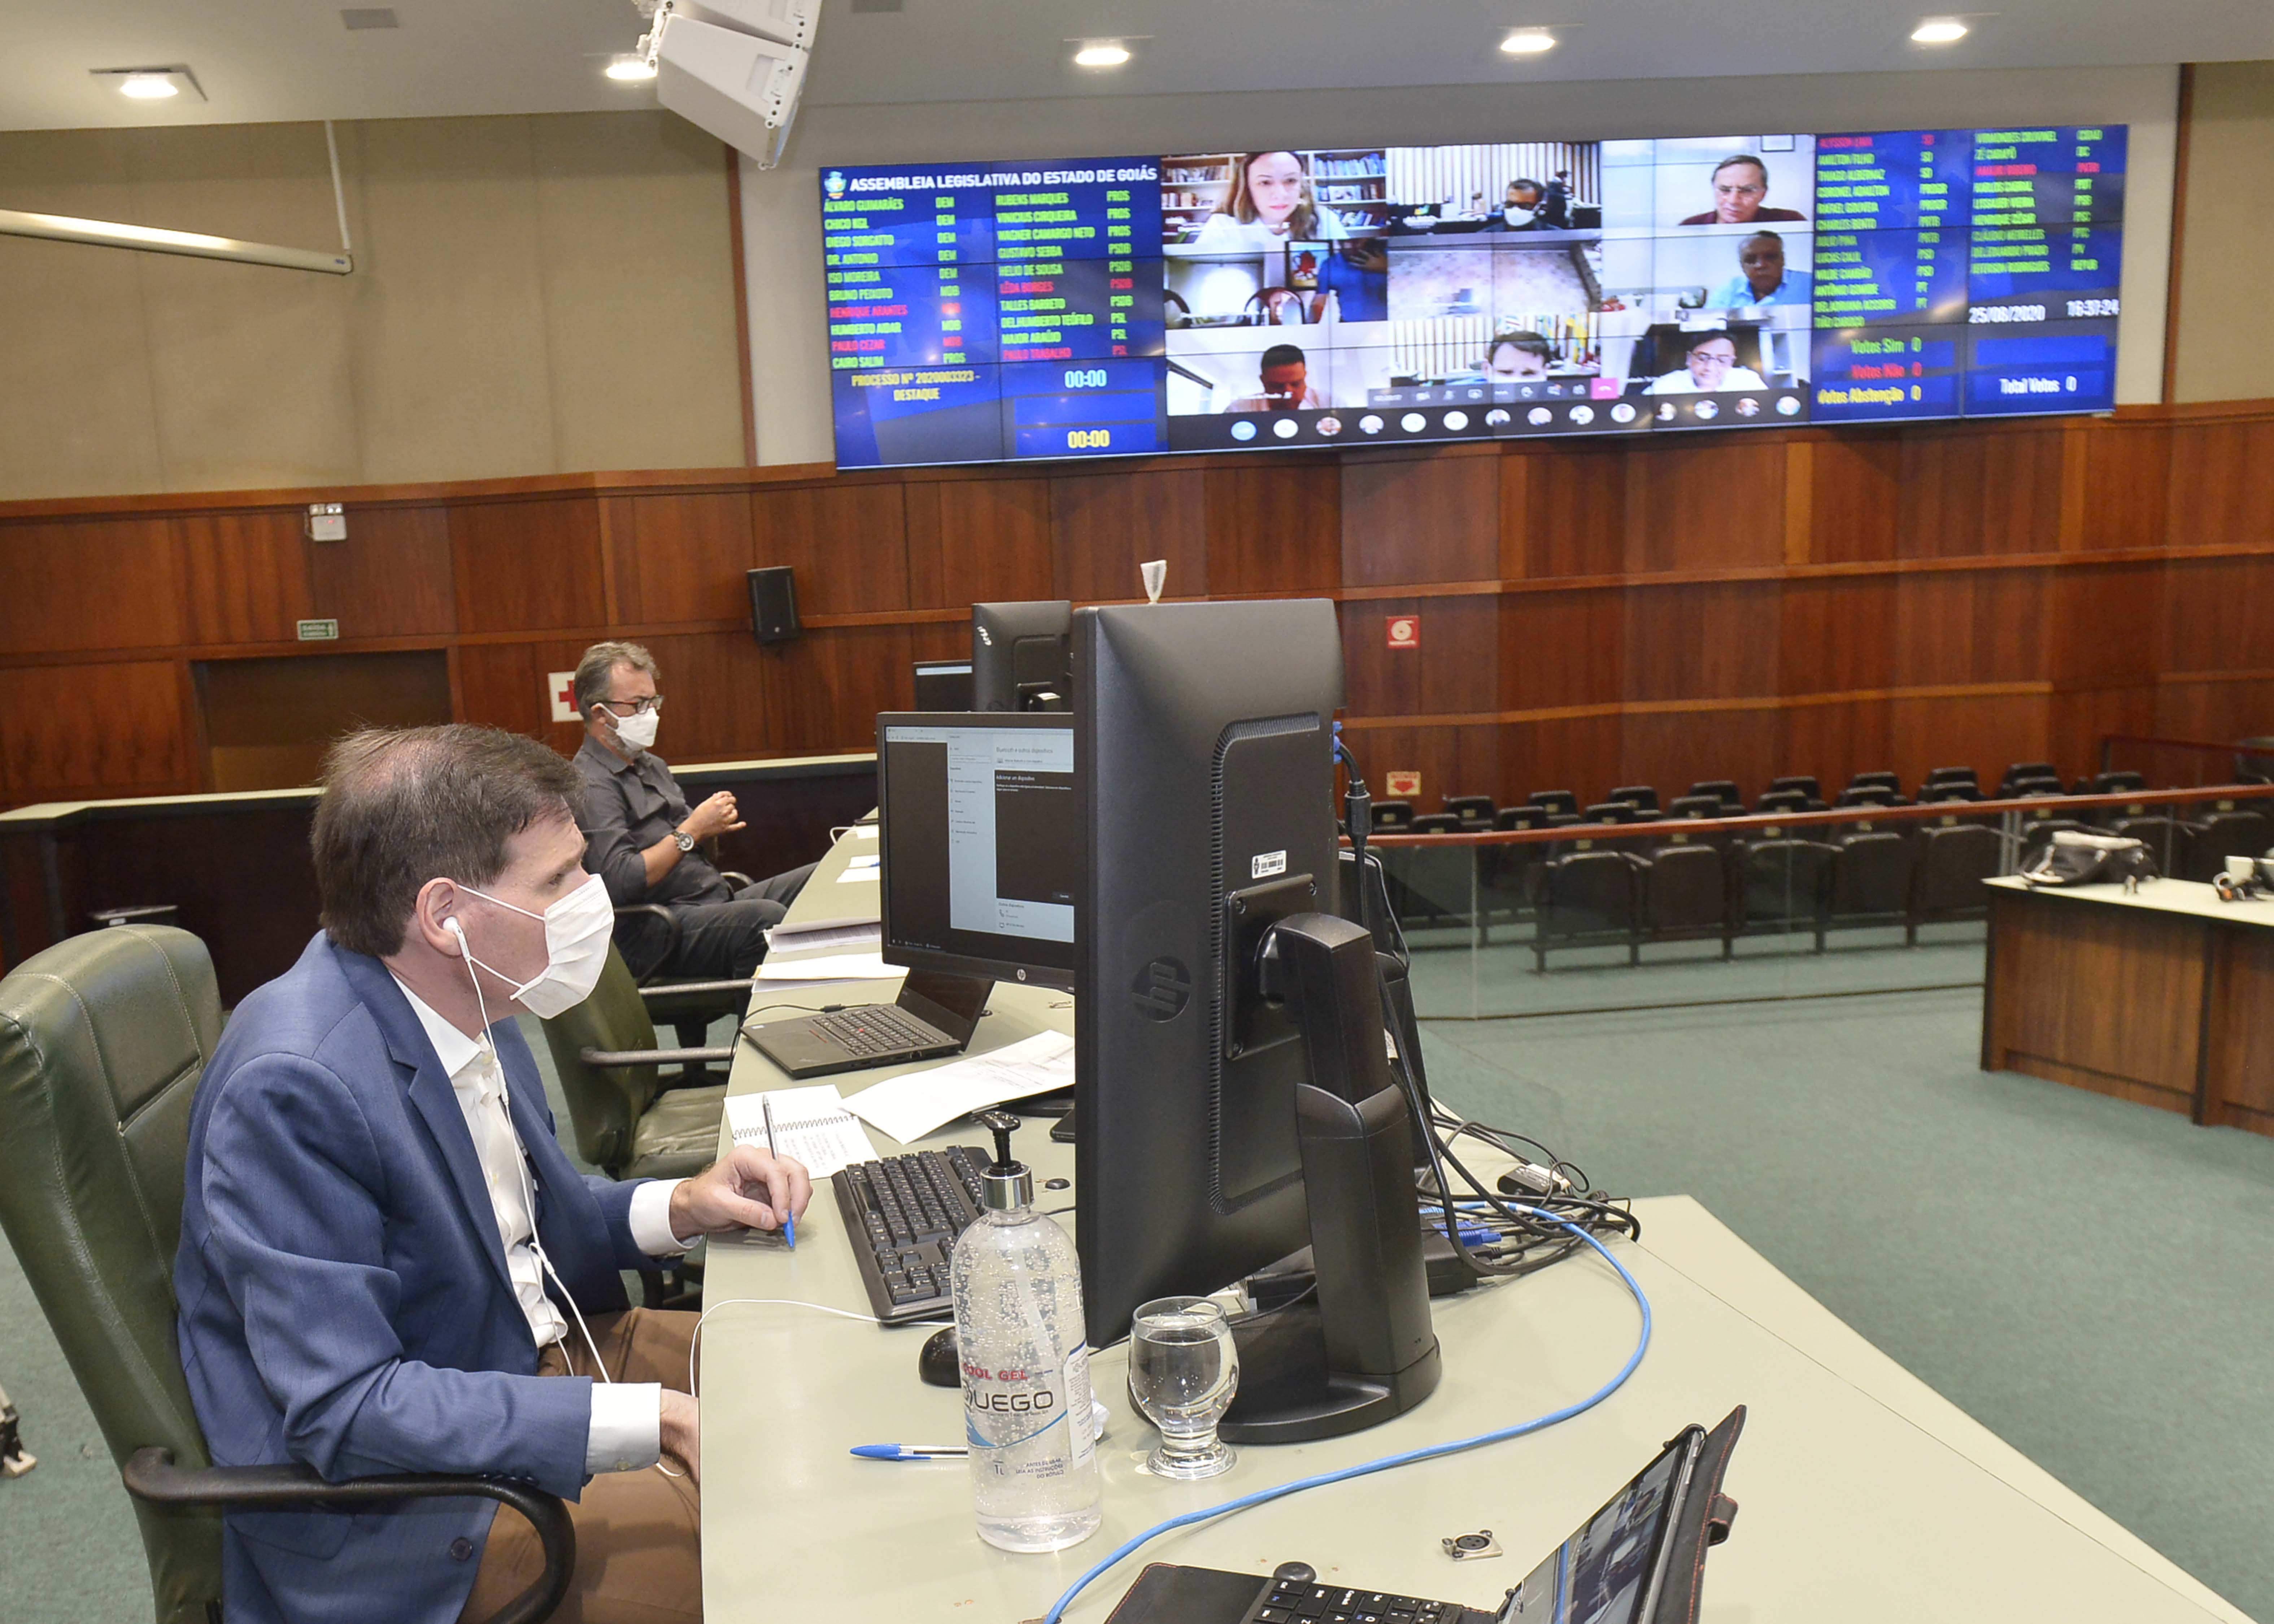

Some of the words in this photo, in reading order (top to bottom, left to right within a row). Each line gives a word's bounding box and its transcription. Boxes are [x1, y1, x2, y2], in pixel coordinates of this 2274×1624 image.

[849, 176, 935, 191] ASSEMBLEIA
[936, 173, 1021, 188] LEGISLATIVA
[1022, 172, 1041, 185] DO
[1043, 170, 1095, 184] ESTADO
[1097, 169, 1116, 183] DE
[1117, 164, 1157, 180] GOIÁS
[1850, 339, 1882, 354] Votos
[1882, 338, 1904, 353] Sim
[1911, 337, 1922, 353] 0
[851, 373, 900, 387] PROCESSO
[1065, 369, 1107, 388] 00:00
[1999, 378, 2028, 394] Total
[2028, 377, 2060, 393] Votos
[2065, 375, 2077, 392] 0
[893, 388, 941, 401] DESTAQUE
[1911, 385, 1921, 401] 0
[1067, 429, 1110, 449] 00:00
[998, 1370, 1028, 1381] GEL
